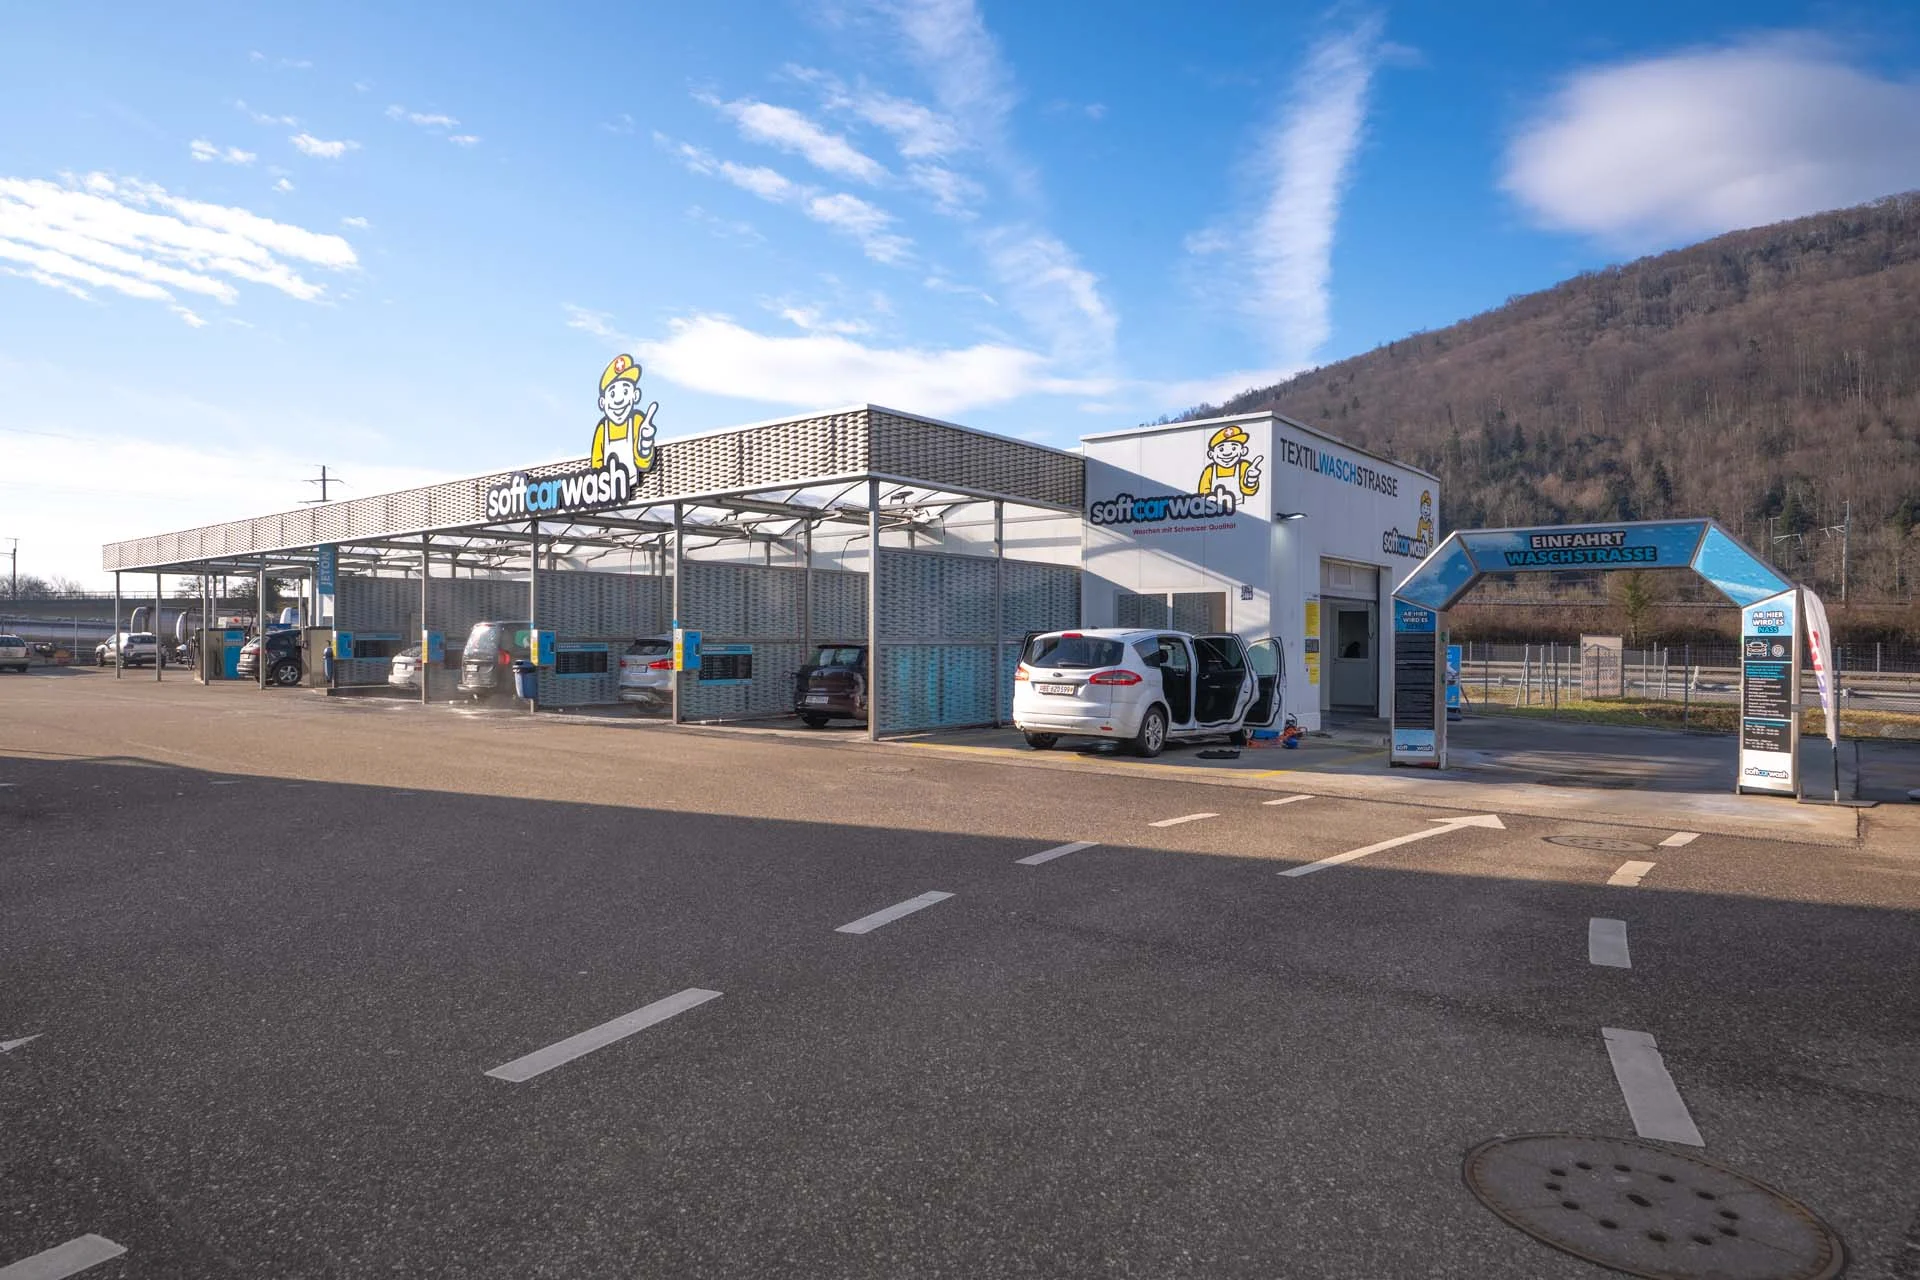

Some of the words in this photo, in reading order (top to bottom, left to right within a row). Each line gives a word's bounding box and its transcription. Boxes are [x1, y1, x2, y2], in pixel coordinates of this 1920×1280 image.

[1280, 438, 1399, 497] TEXTILWASCHSTRASSE
[487, 457, 628, 517] softcarwash
[1092, 486, 1233, 524] softcarwash
[1132, 527, 1160, 536] Waschen
[1174, 524, 1207, 533] Schweizer
[1383, 527, 1428, 559] softcarwash
[1531, 532, 1625, 549] EINFAHRT
[1505, 547, 1657, 566] WASCHSTRASSE
[321, 551, 333, 587] JETON
[1753, 611, 1764, 619] AB
[1766, 611, 1784, 619] HIER
[1775, 618, 1785, 626] ES
[1744, 767, 1789, 780] softcarwash
